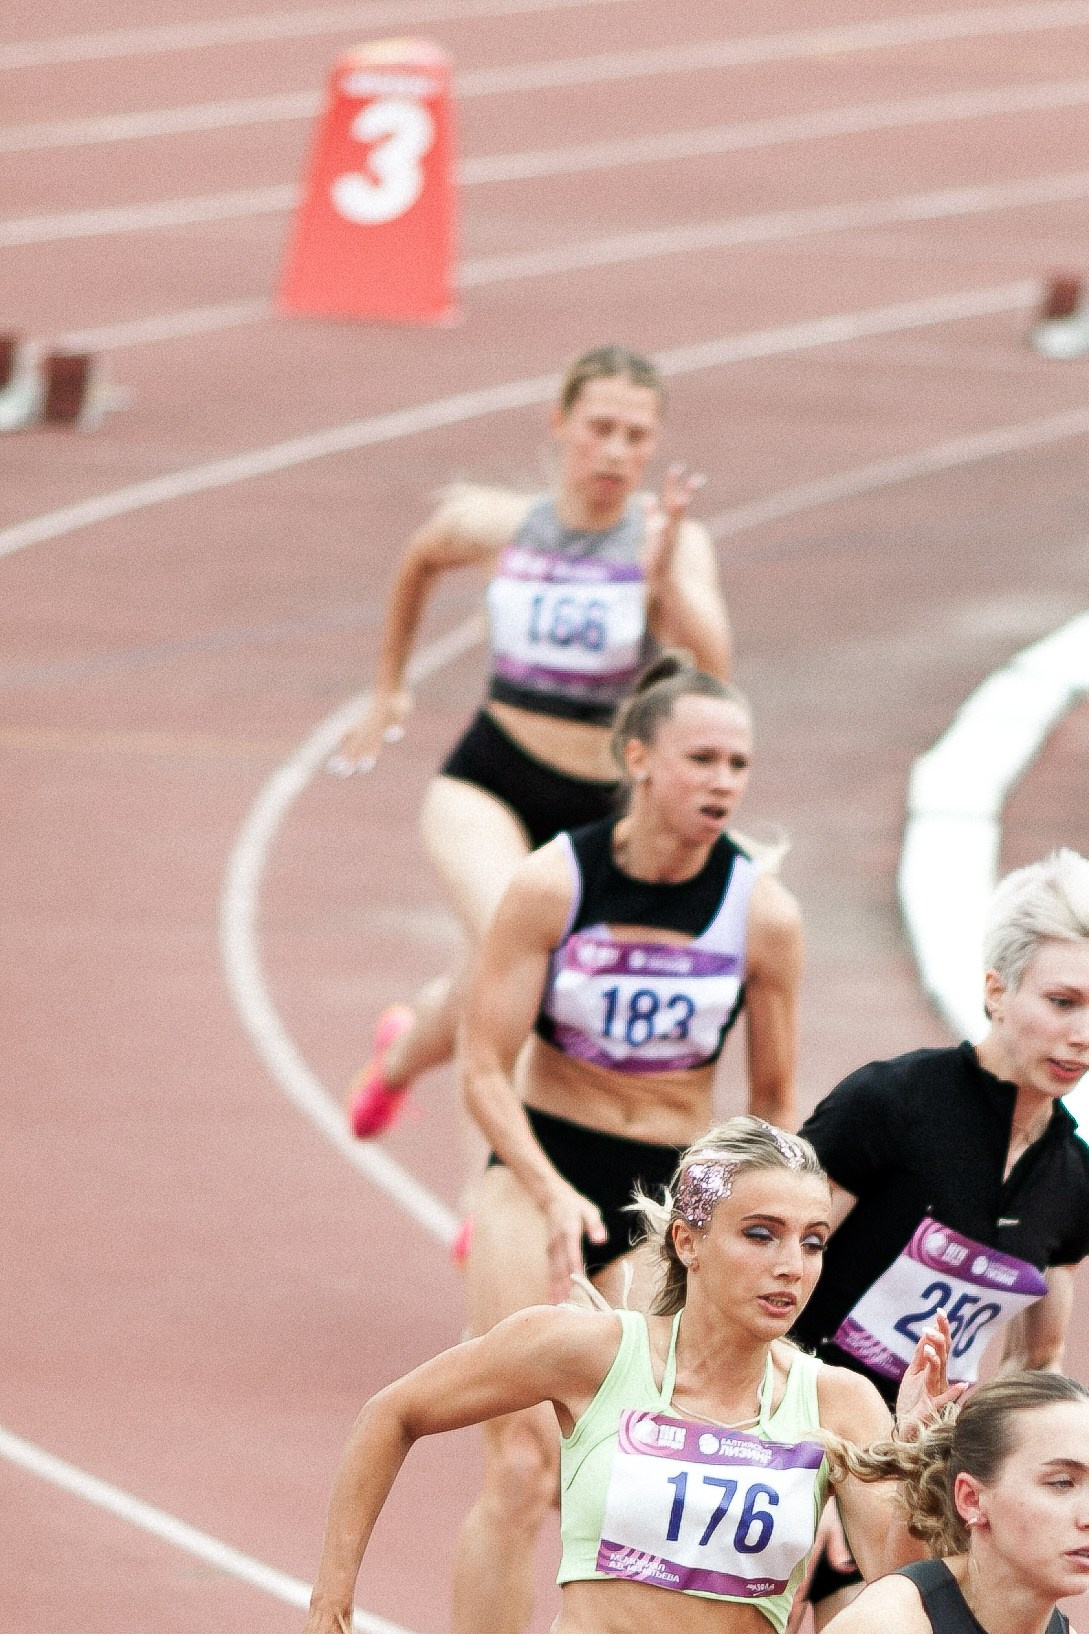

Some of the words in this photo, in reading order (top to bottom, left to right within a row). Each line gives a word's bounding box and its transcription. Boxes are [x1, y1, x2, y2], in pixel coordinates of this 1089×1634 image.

[330, 99, 436, 226] 3
[602, 985, 696, 1046] 183
[666, 1471, 780, 1553] 176
